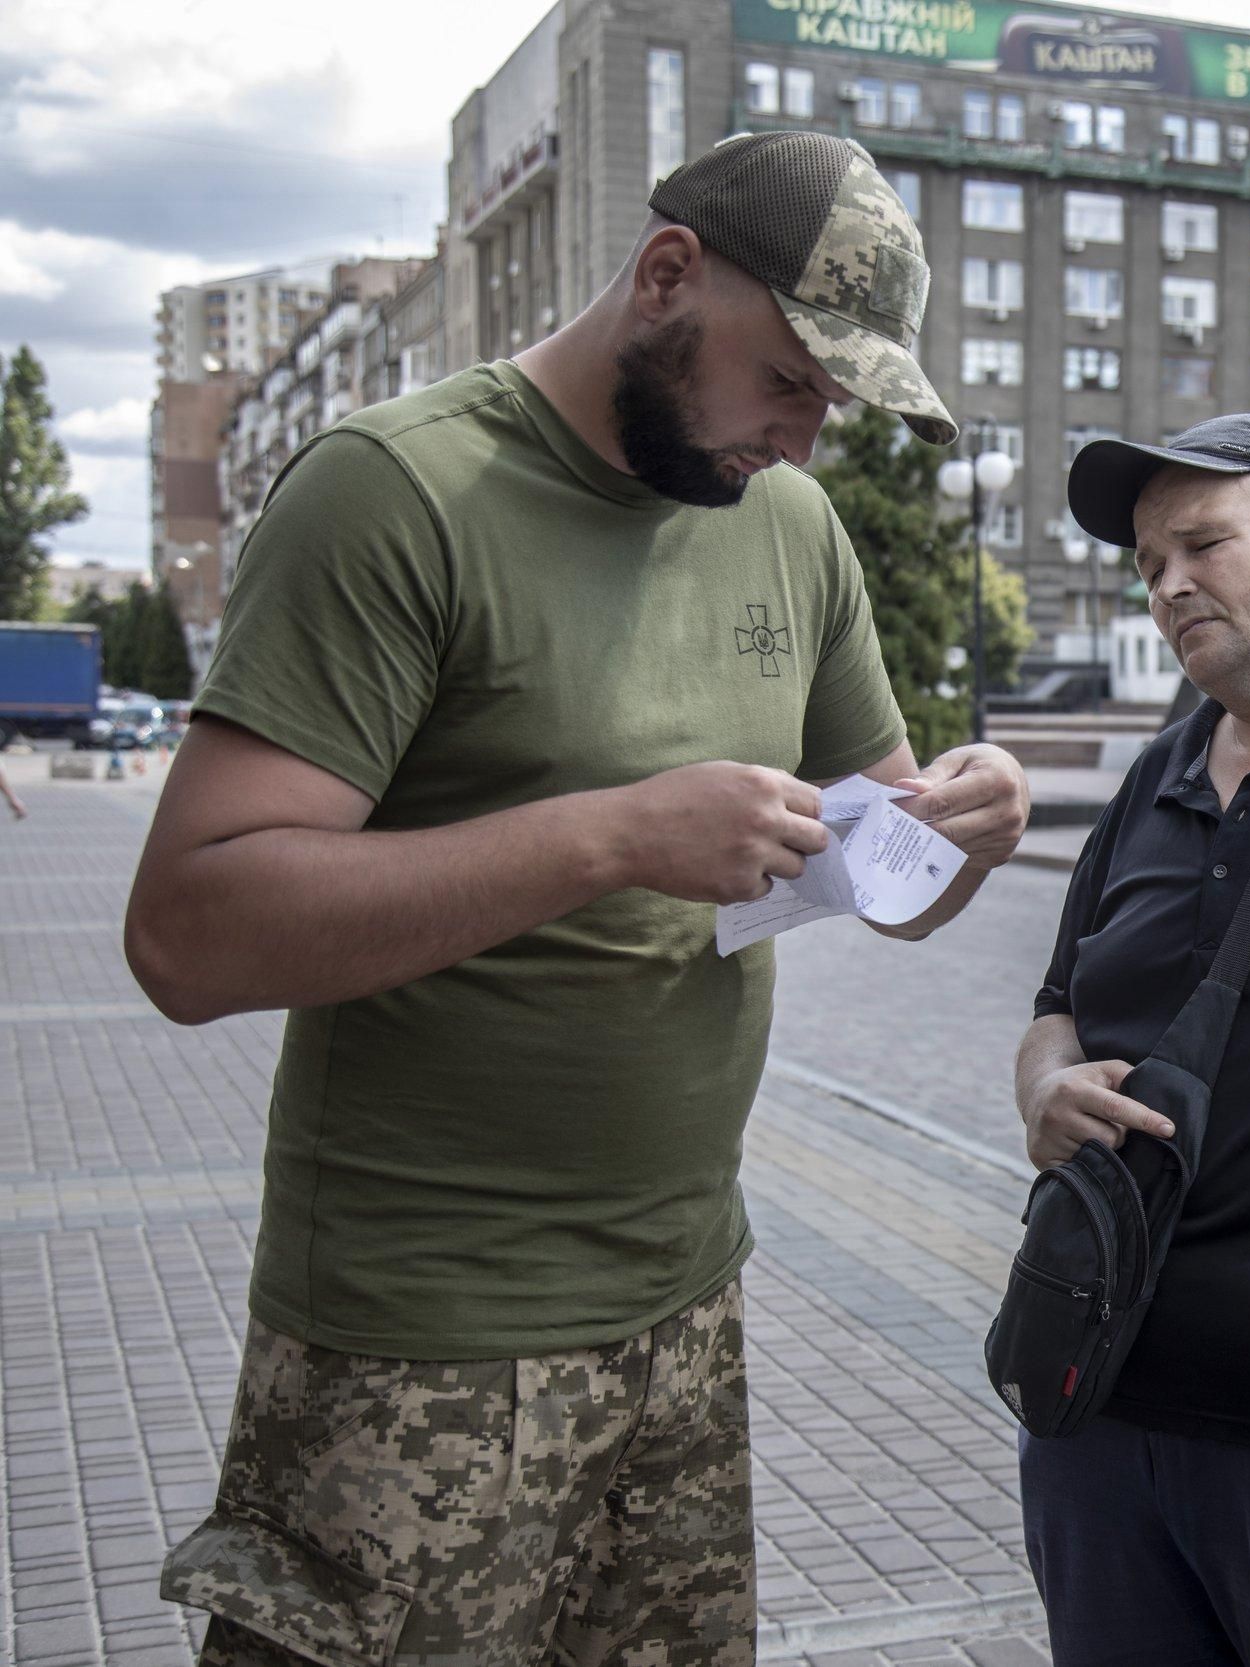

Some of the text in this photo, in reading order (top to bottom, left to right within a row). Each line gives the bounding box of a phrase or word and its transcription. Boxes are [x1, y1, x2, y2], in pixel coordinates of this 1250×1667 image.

[797, 12, 948, 57] КАШТАН
[1033, 40, 1156, 73] КАШТАН
[1225, 71, 1248, 98] В
